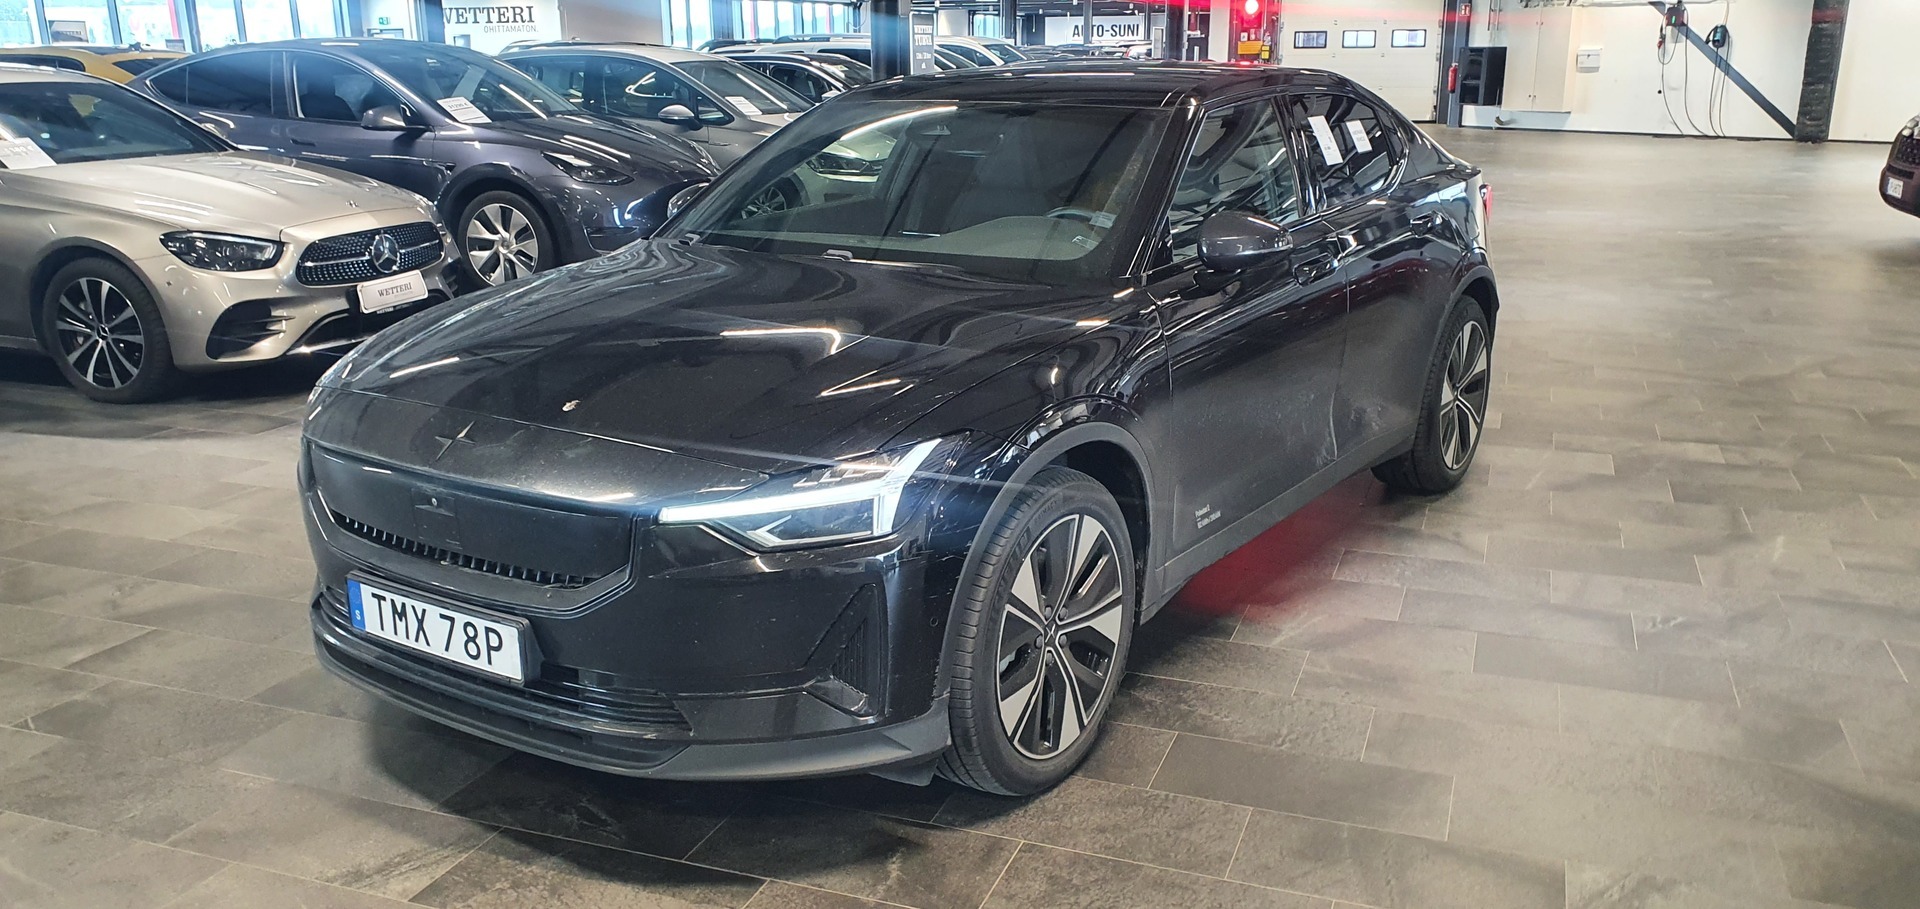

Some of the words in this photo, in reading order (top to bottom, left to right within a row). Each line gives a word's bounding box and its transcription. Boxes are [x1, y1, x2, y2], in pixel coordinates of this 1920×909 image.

[377, 282, 412, 297] WETTERI
[355, 609, 361, 620] S
[371, 592, 430, 647] TMX
[439, 613, 503, 666] 78P
